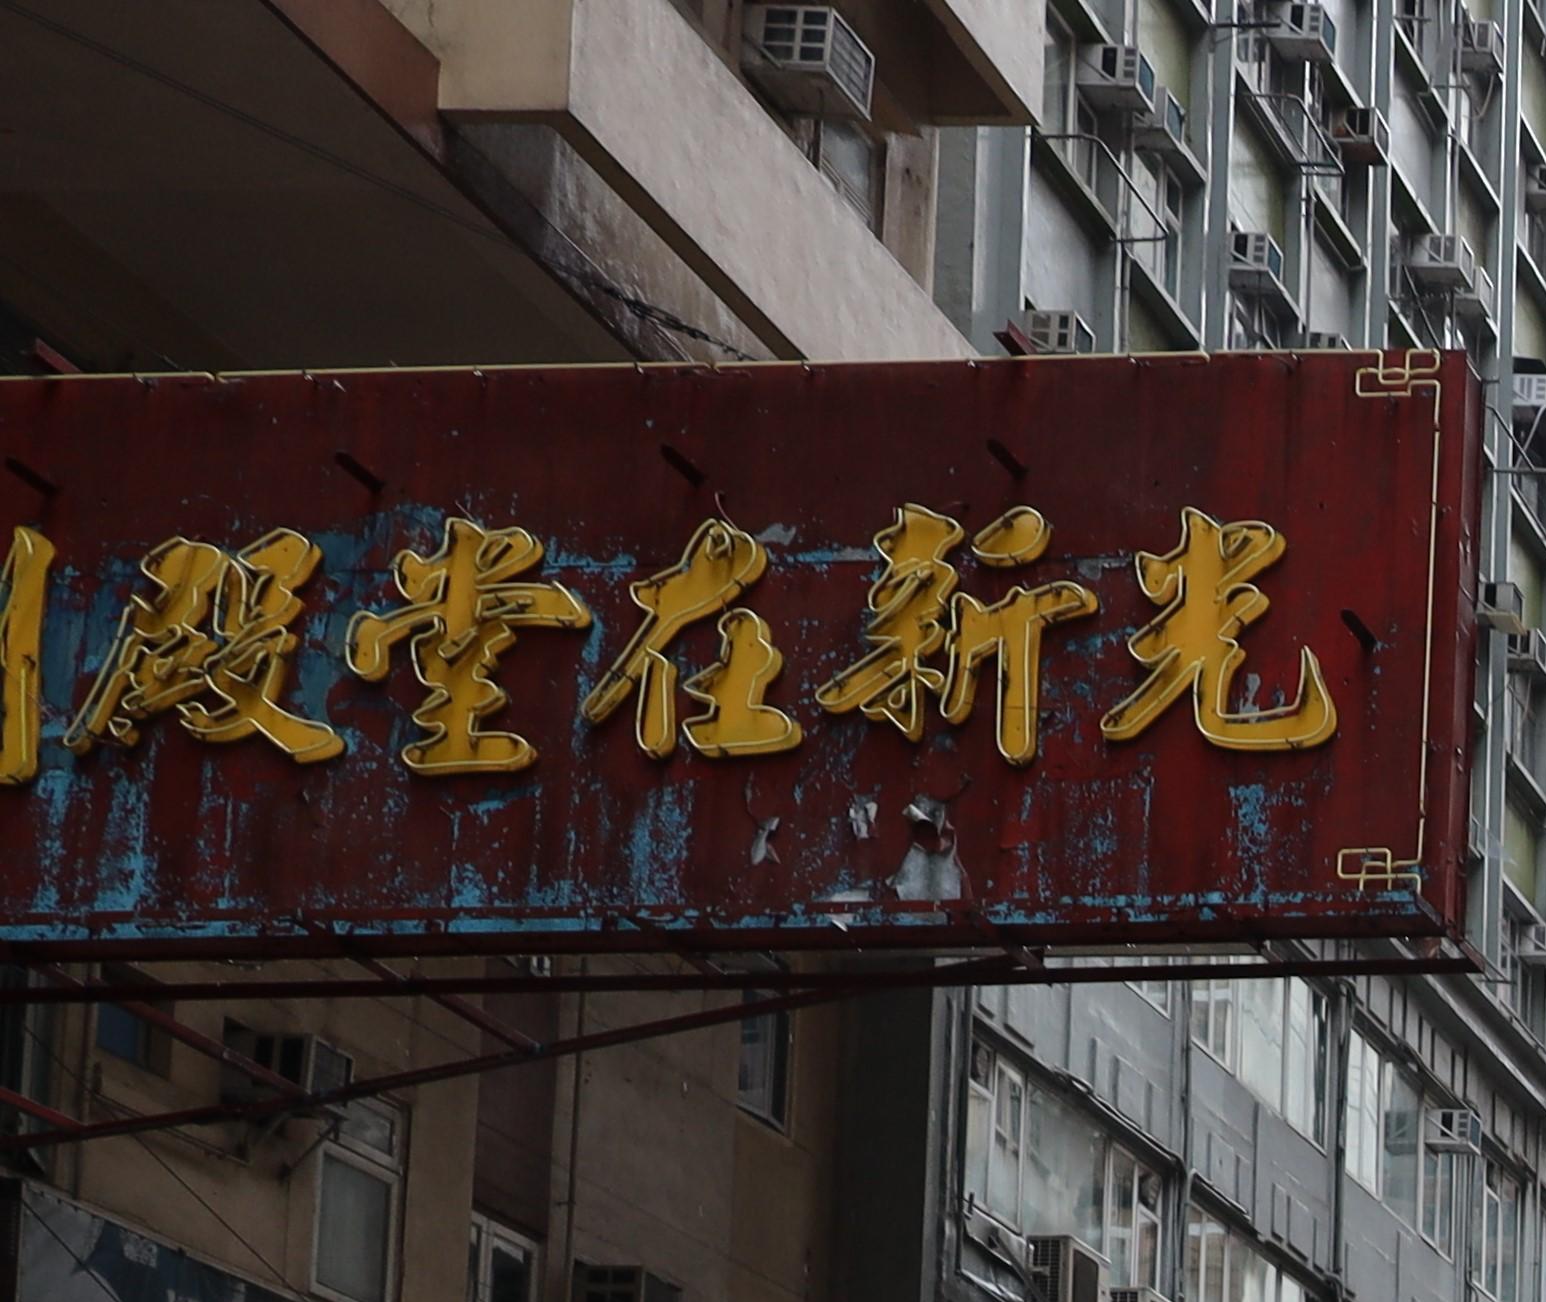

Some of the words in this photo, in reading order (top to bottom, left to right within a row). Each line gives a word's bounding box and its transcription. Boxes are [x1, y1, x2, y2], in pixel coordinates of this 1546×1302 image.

[0, 504, 1339, 786] 殿堂在新光
